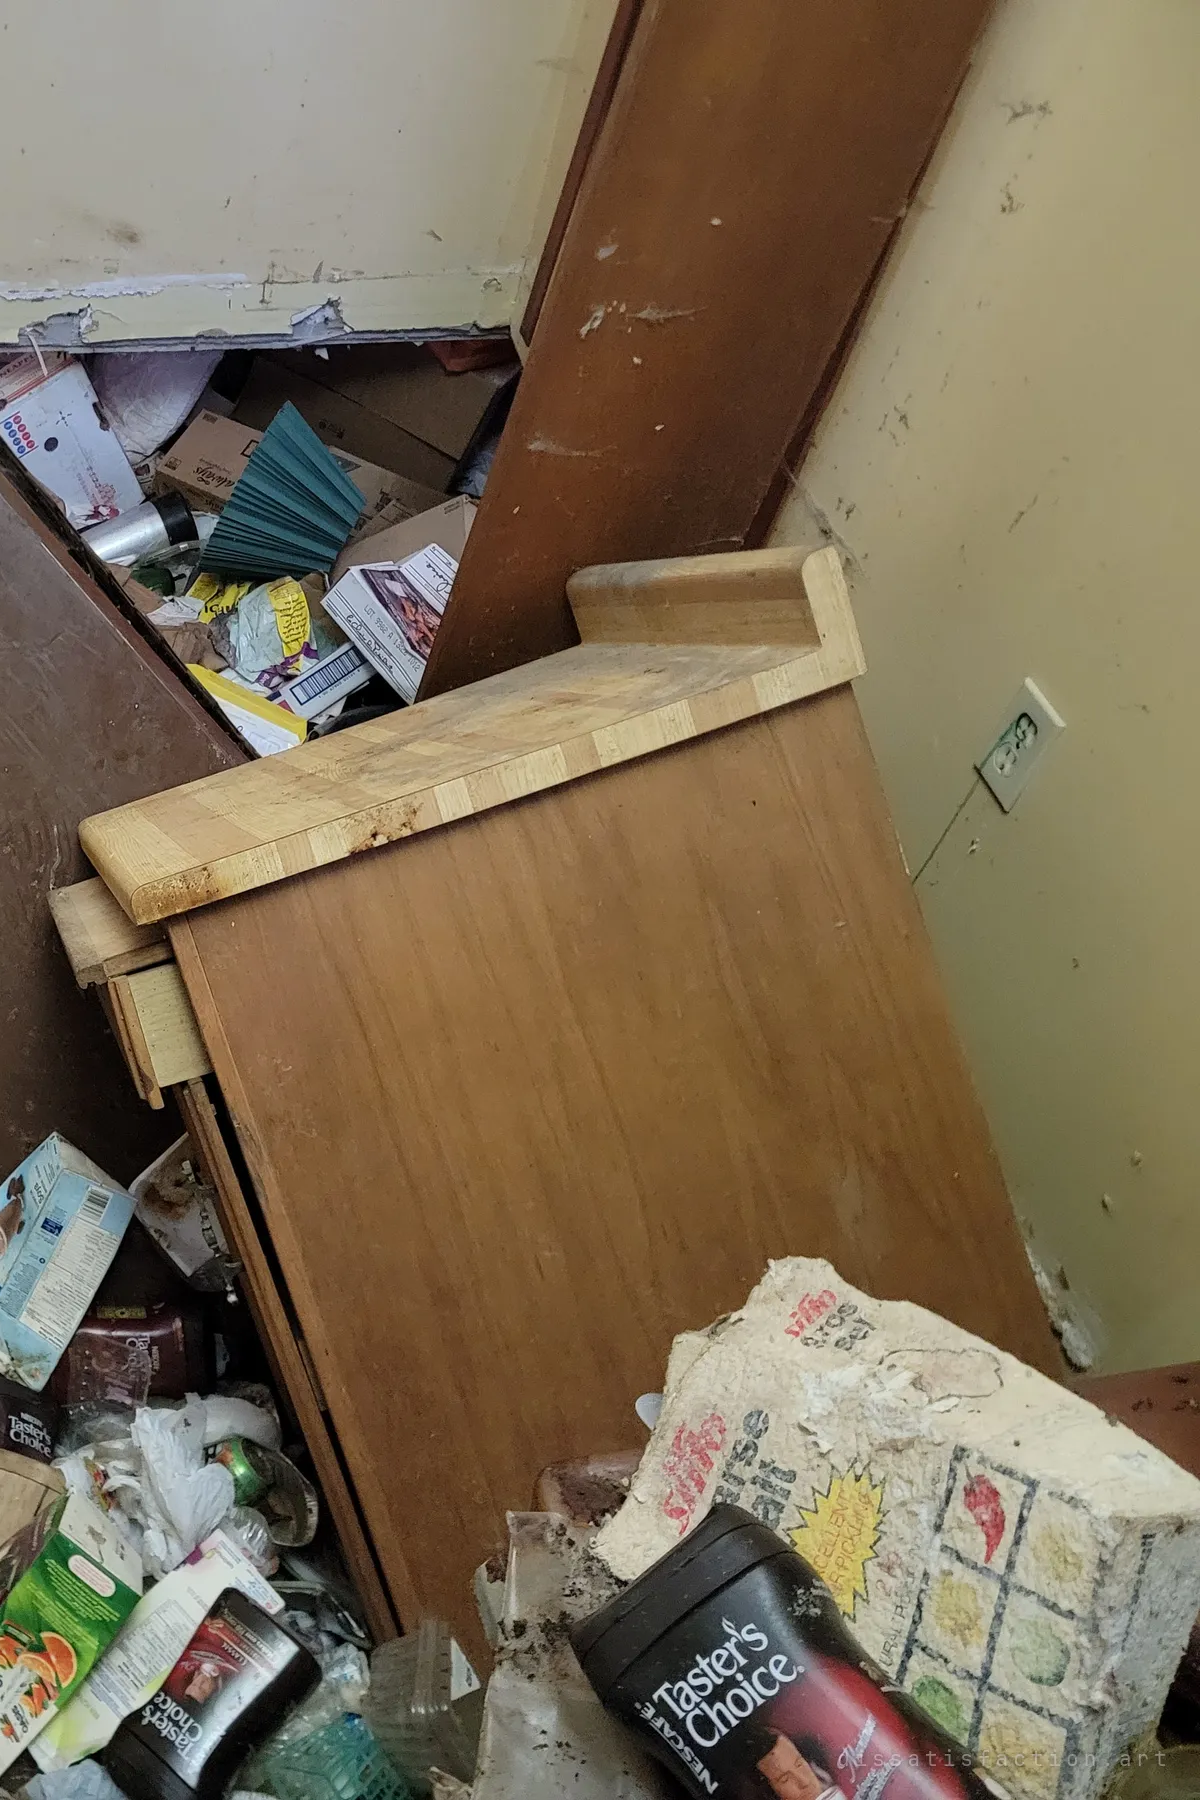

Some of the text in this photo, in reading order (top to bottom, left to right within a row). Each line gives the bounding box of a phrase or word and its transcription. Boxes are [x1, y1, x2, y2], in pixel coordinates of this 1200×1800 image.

[8, 1415, 51, 1446] Taster's
[9, 1429, 52, 1457] Choice
[712, 1410, 770, 1504] arse
[750, 1457, 797, 1530] alt
[812, 1489, 851, 1576] CELLENT
[653, 1616, 769, 1719] Taster's
[685, 1654, 798, 1748] Choice
[10, 1704, 29, 1734] OASIS
[142, 1704, 192, 1761] Taster's
[154, 1690, 203, 1742] Choice
[634, 1701, 719, 1795] NESCAFÉ
